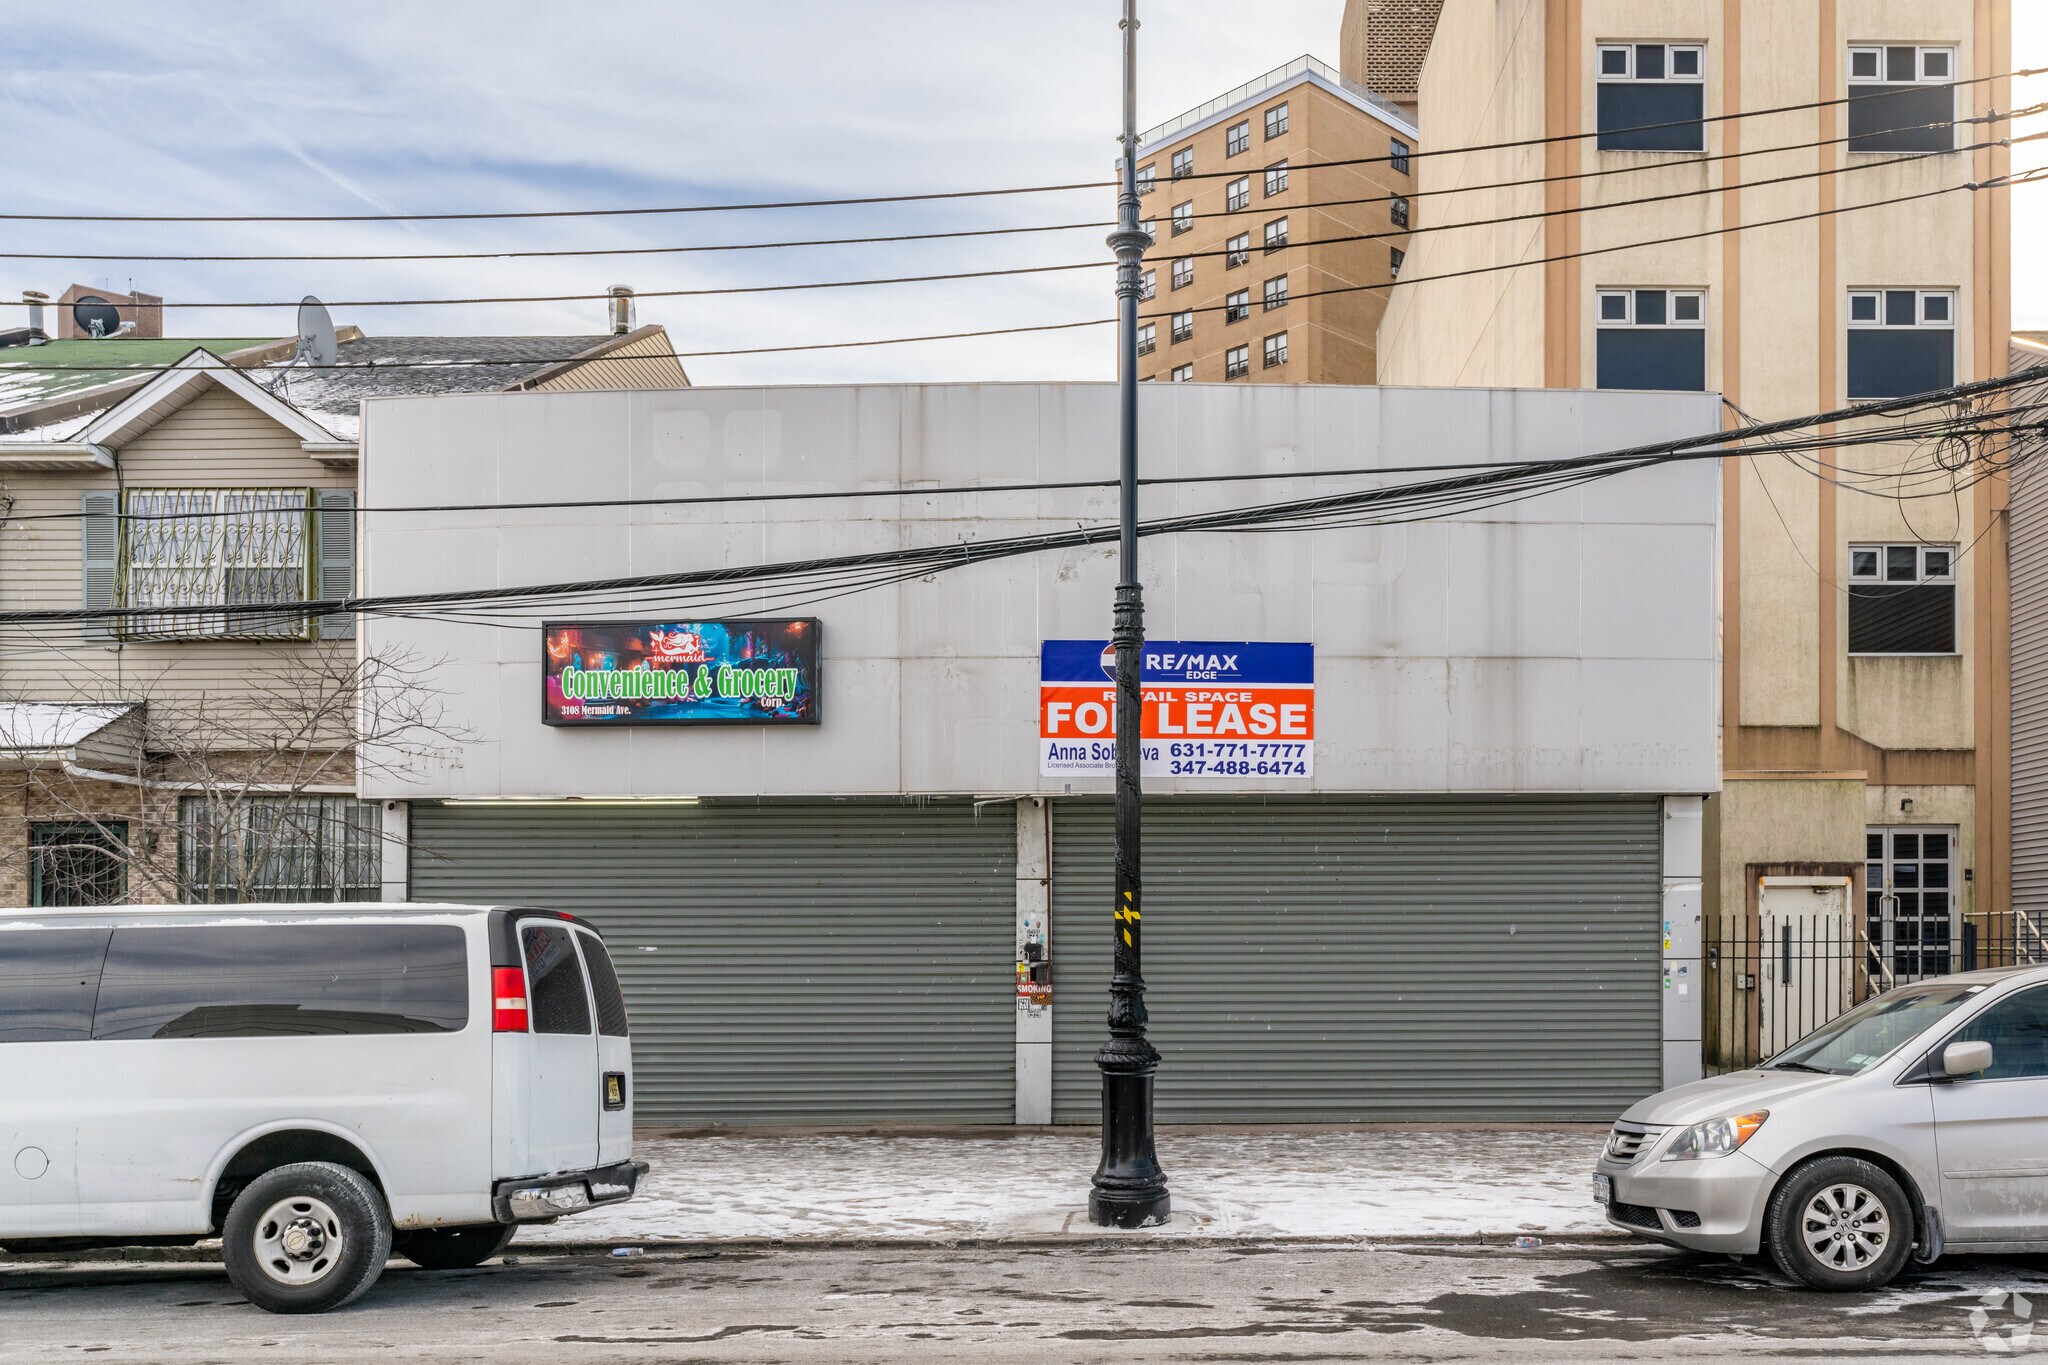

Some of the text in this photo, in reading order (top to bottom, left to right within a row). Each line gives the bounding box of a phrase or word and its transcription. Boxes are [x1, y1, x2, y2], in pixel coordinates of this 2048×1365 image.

[653, 651, 706, 663] mermaid
[1146, 654, 1238, 671] RE/MAX
[562, 664, 798, 700] Convenience & Grocery
[1186, 671, 1217, 680] EDGE
[760, 697, 786, 708] Corp.
[1103, 691, 1252, 702] RTAIL SPACE
[561, 705, 631, 715] 3108 Mermaid Ave.
[1158, 703, 1307, 735] LEASE
[1048, 743, 1087, 760] Anna
[1170, 743, 1306, 757] 631-771-7777
[1170, 760, 1306, 775] 347-488-6474
